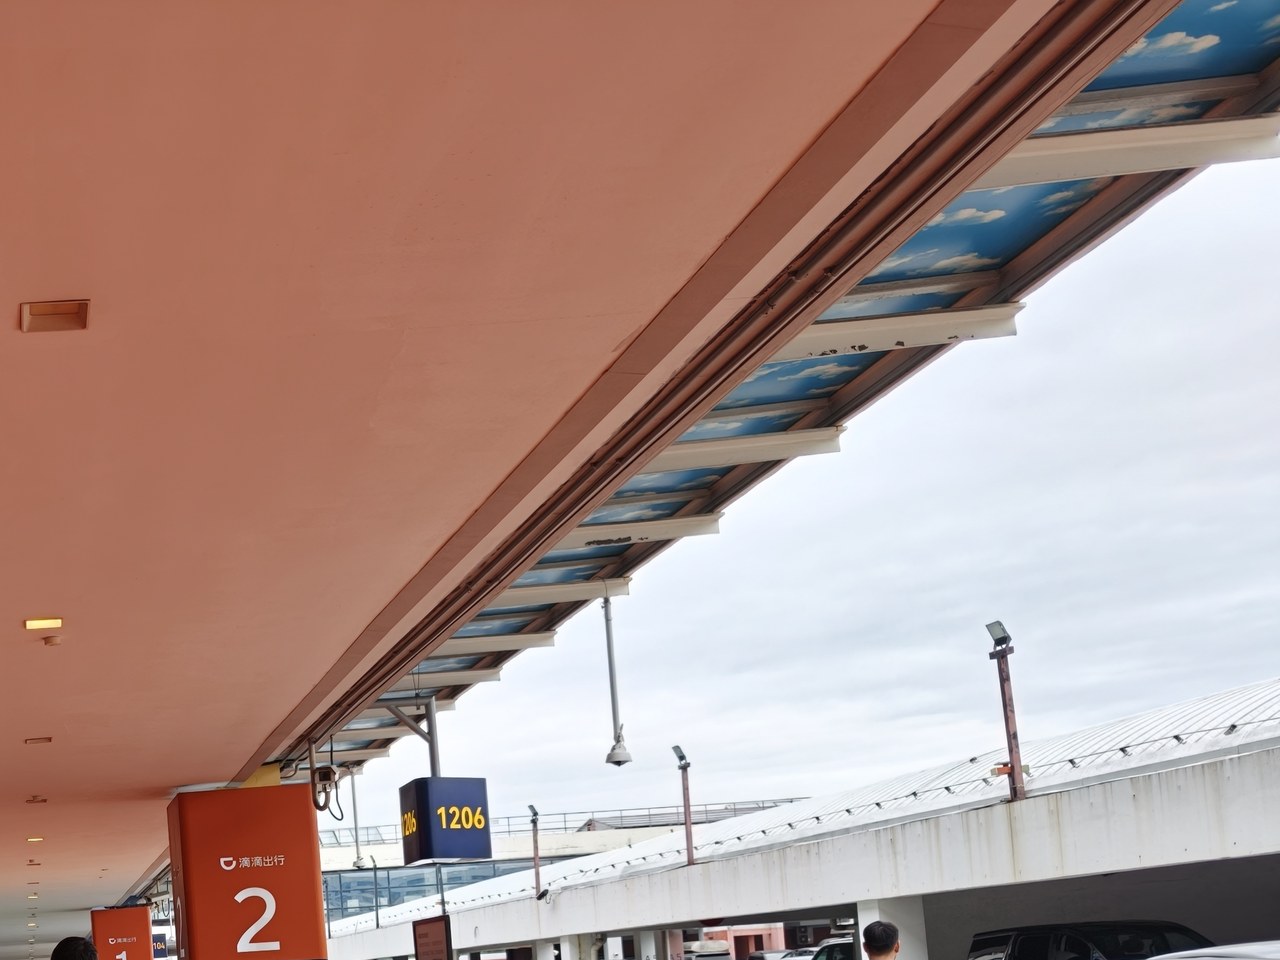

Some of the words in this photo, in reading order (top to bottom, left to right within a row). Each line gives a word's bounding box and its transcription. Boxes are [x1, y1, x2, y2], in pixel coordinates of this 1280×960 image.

[437, 806, 485, 829] 1206
[238, 854, 285, 869] 滴滴出行
[234, 887, 281, 953] 2
